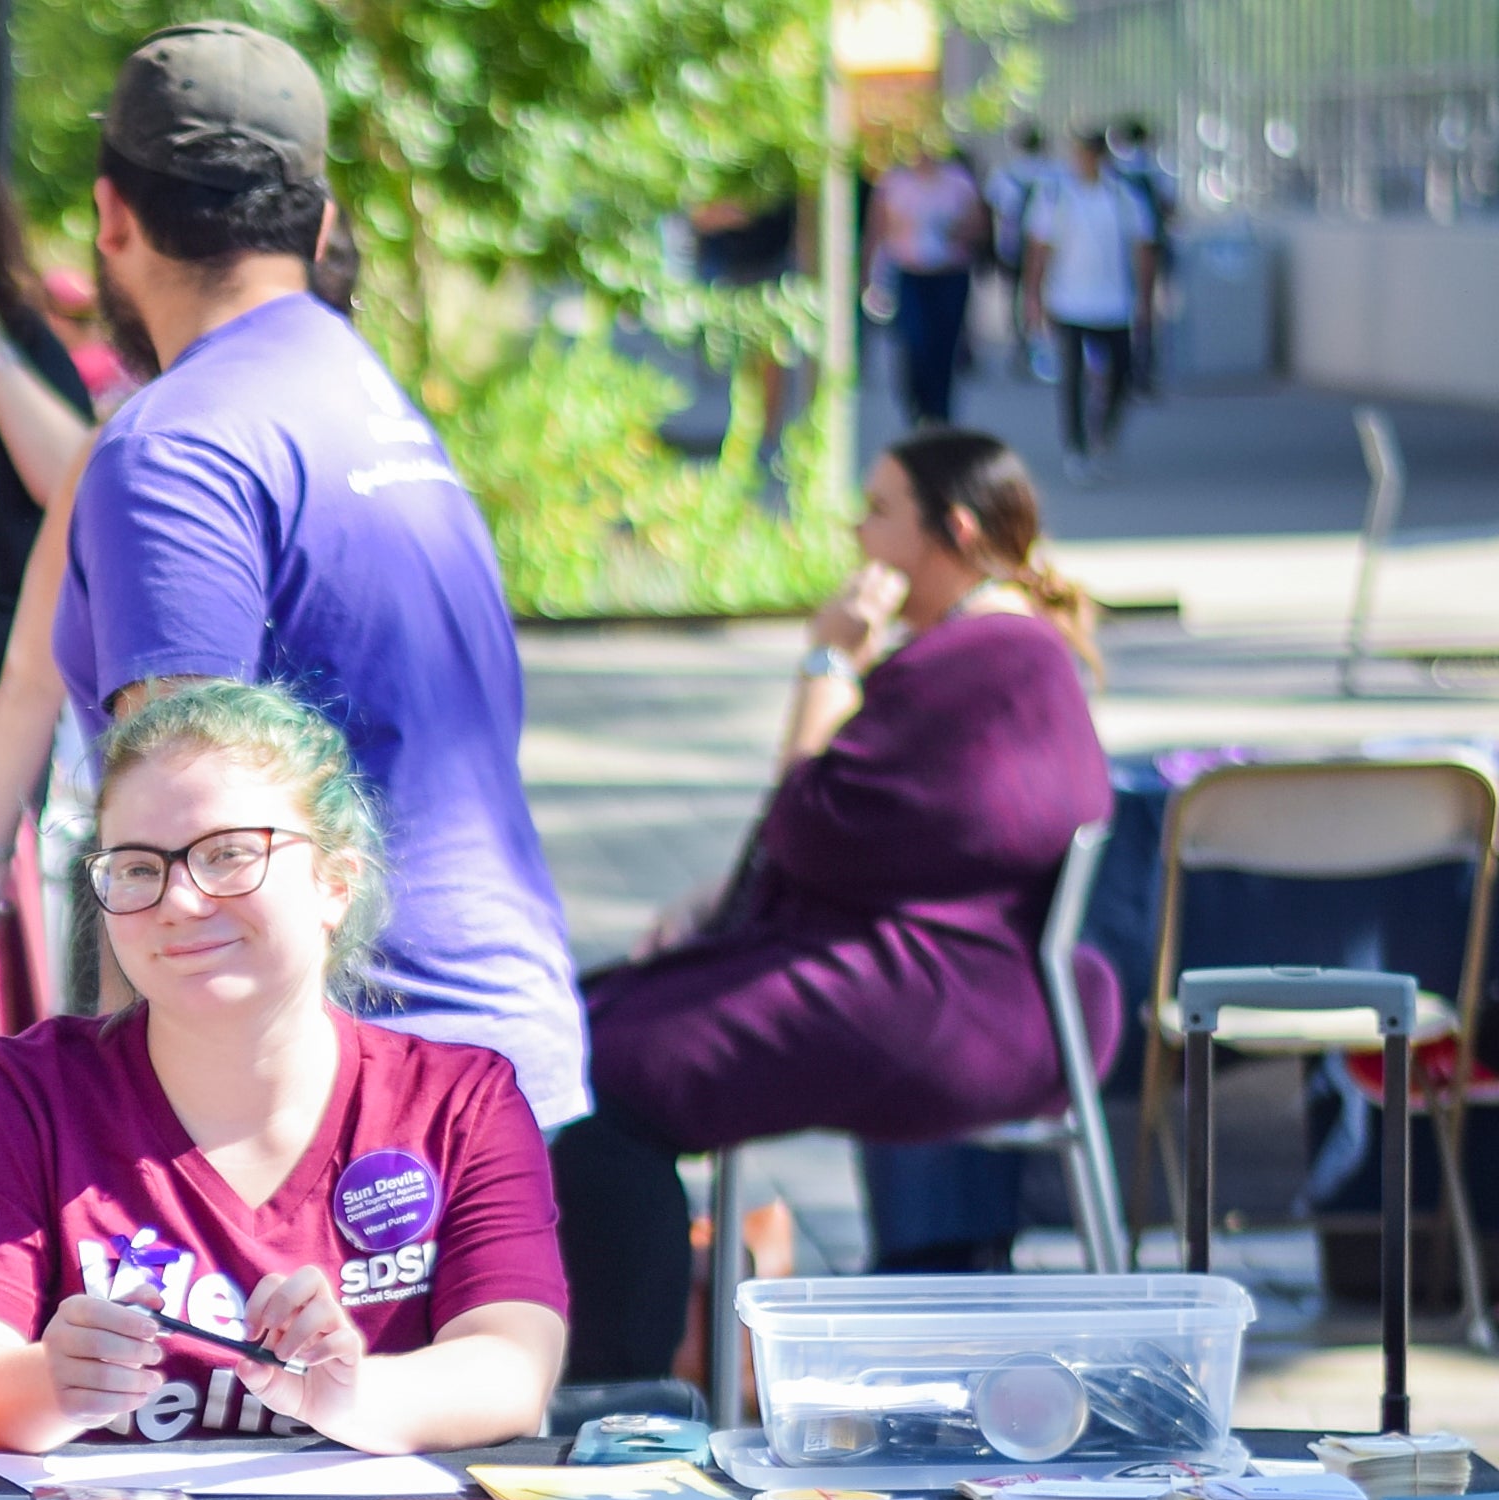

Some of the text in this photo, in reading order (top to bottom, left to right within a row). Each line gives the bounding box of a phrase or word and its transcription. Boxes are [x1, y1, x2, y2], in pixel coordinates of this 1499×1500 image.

[342, 1170, 425, 1205] Sun Devils
[365, 1191, 396, 1208] Together
[397, 1183, 425, 1196] Against
[347, 1191, 427, 1223] Domestic Violence
[363, 1212, 417, 1236] Wear Purple
[341, 1296, 360, 1306] Sun
[361, 1292, 382, 1304] Devil
[384, 1286, 415, 1302] Support
